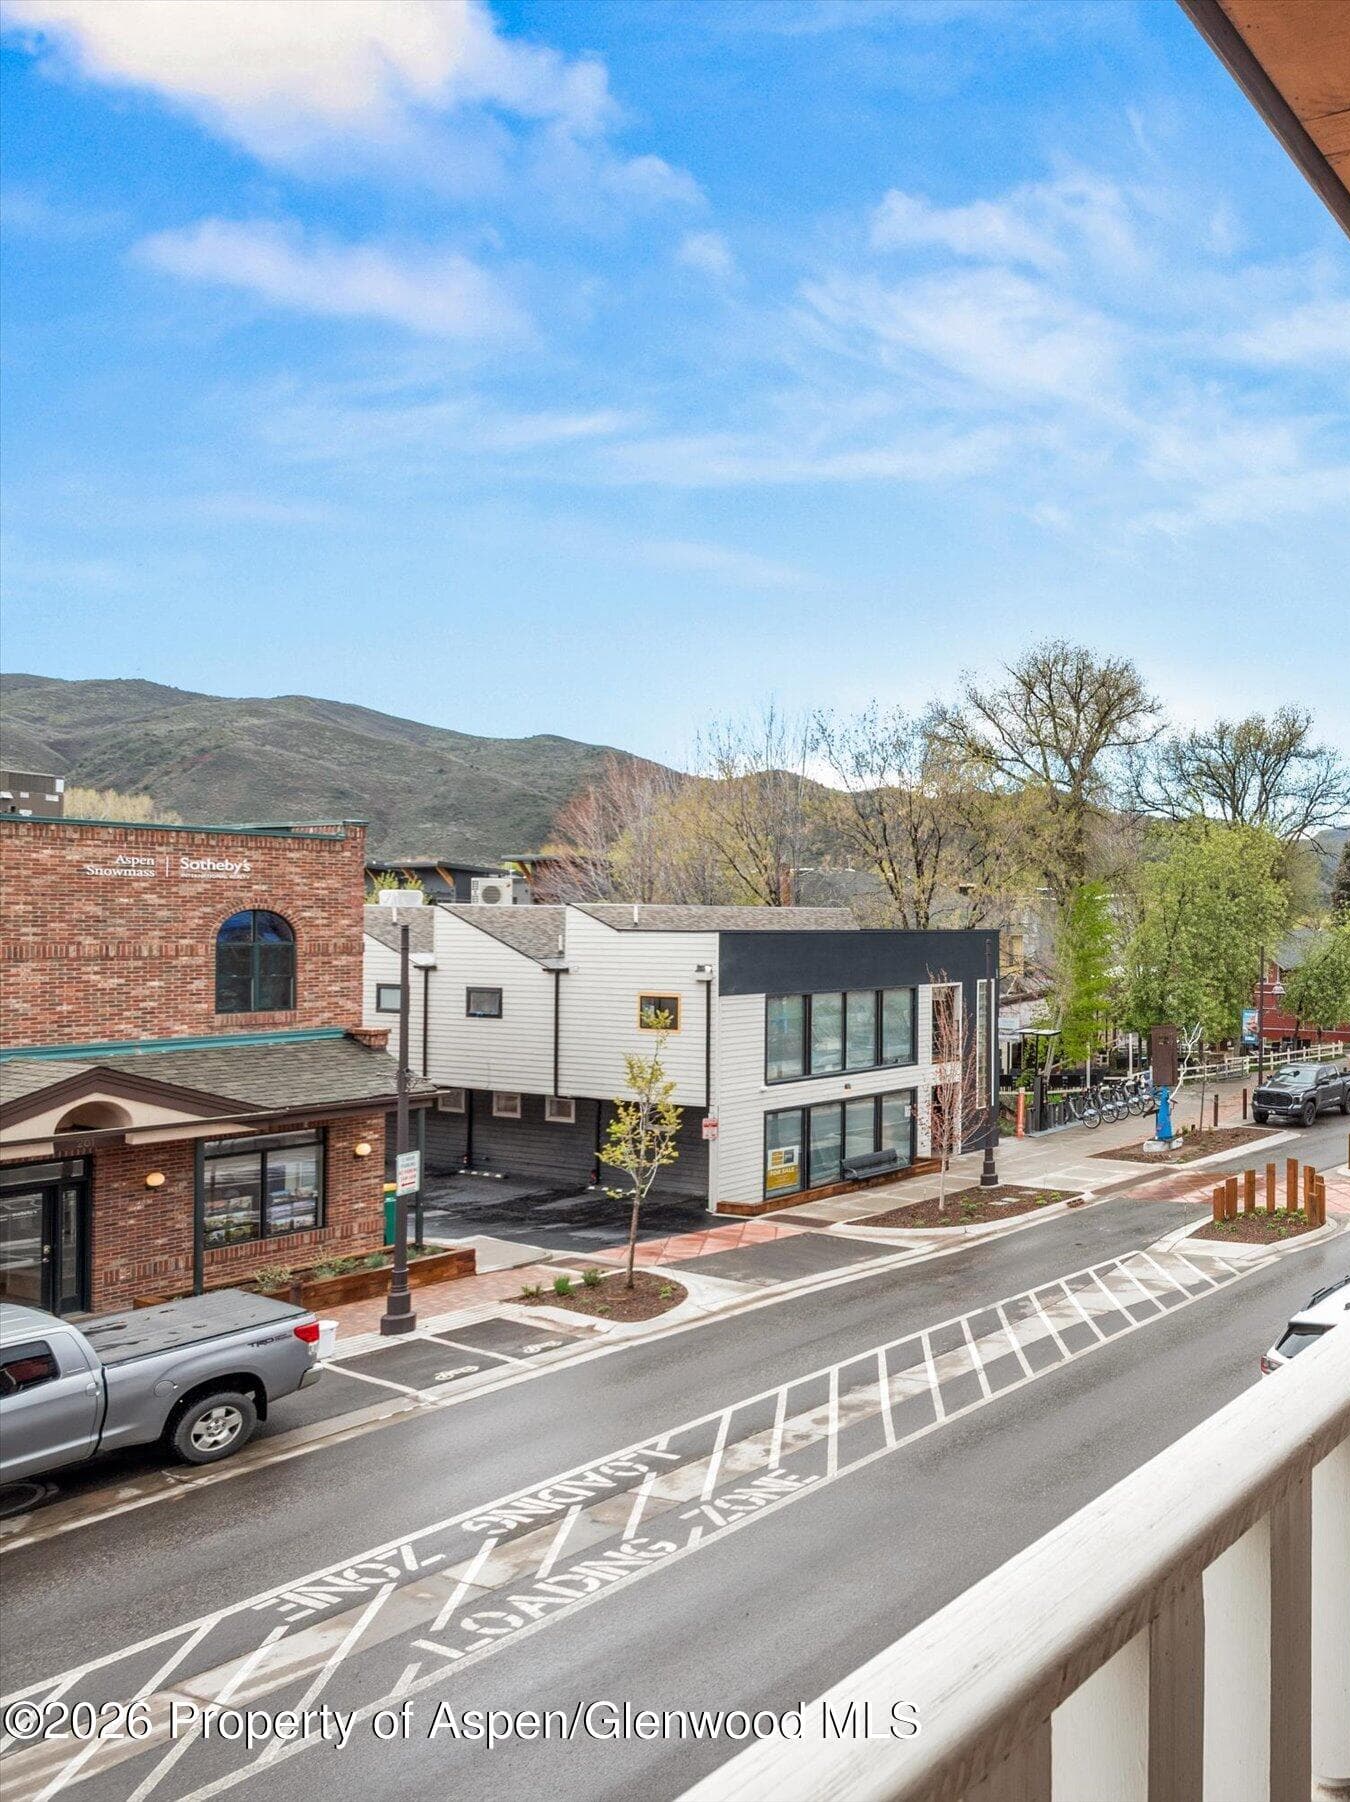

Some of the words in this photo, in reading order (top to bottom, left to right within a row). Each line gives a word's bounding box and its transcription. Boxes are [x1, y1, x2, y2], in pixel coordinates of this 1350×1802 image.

[86, 865, 155, 877] Snowmass
[115, 854, 155, 867] Aspen
[180, 857, 252, 874] Sotheby's
[462, 1448, 682, 1535] LOADING
[253, 1543, 445, 1622] ZONE
[411, 1537, 677, 1659] LOADING
[680, 1468, 819, 1527] ZONE
